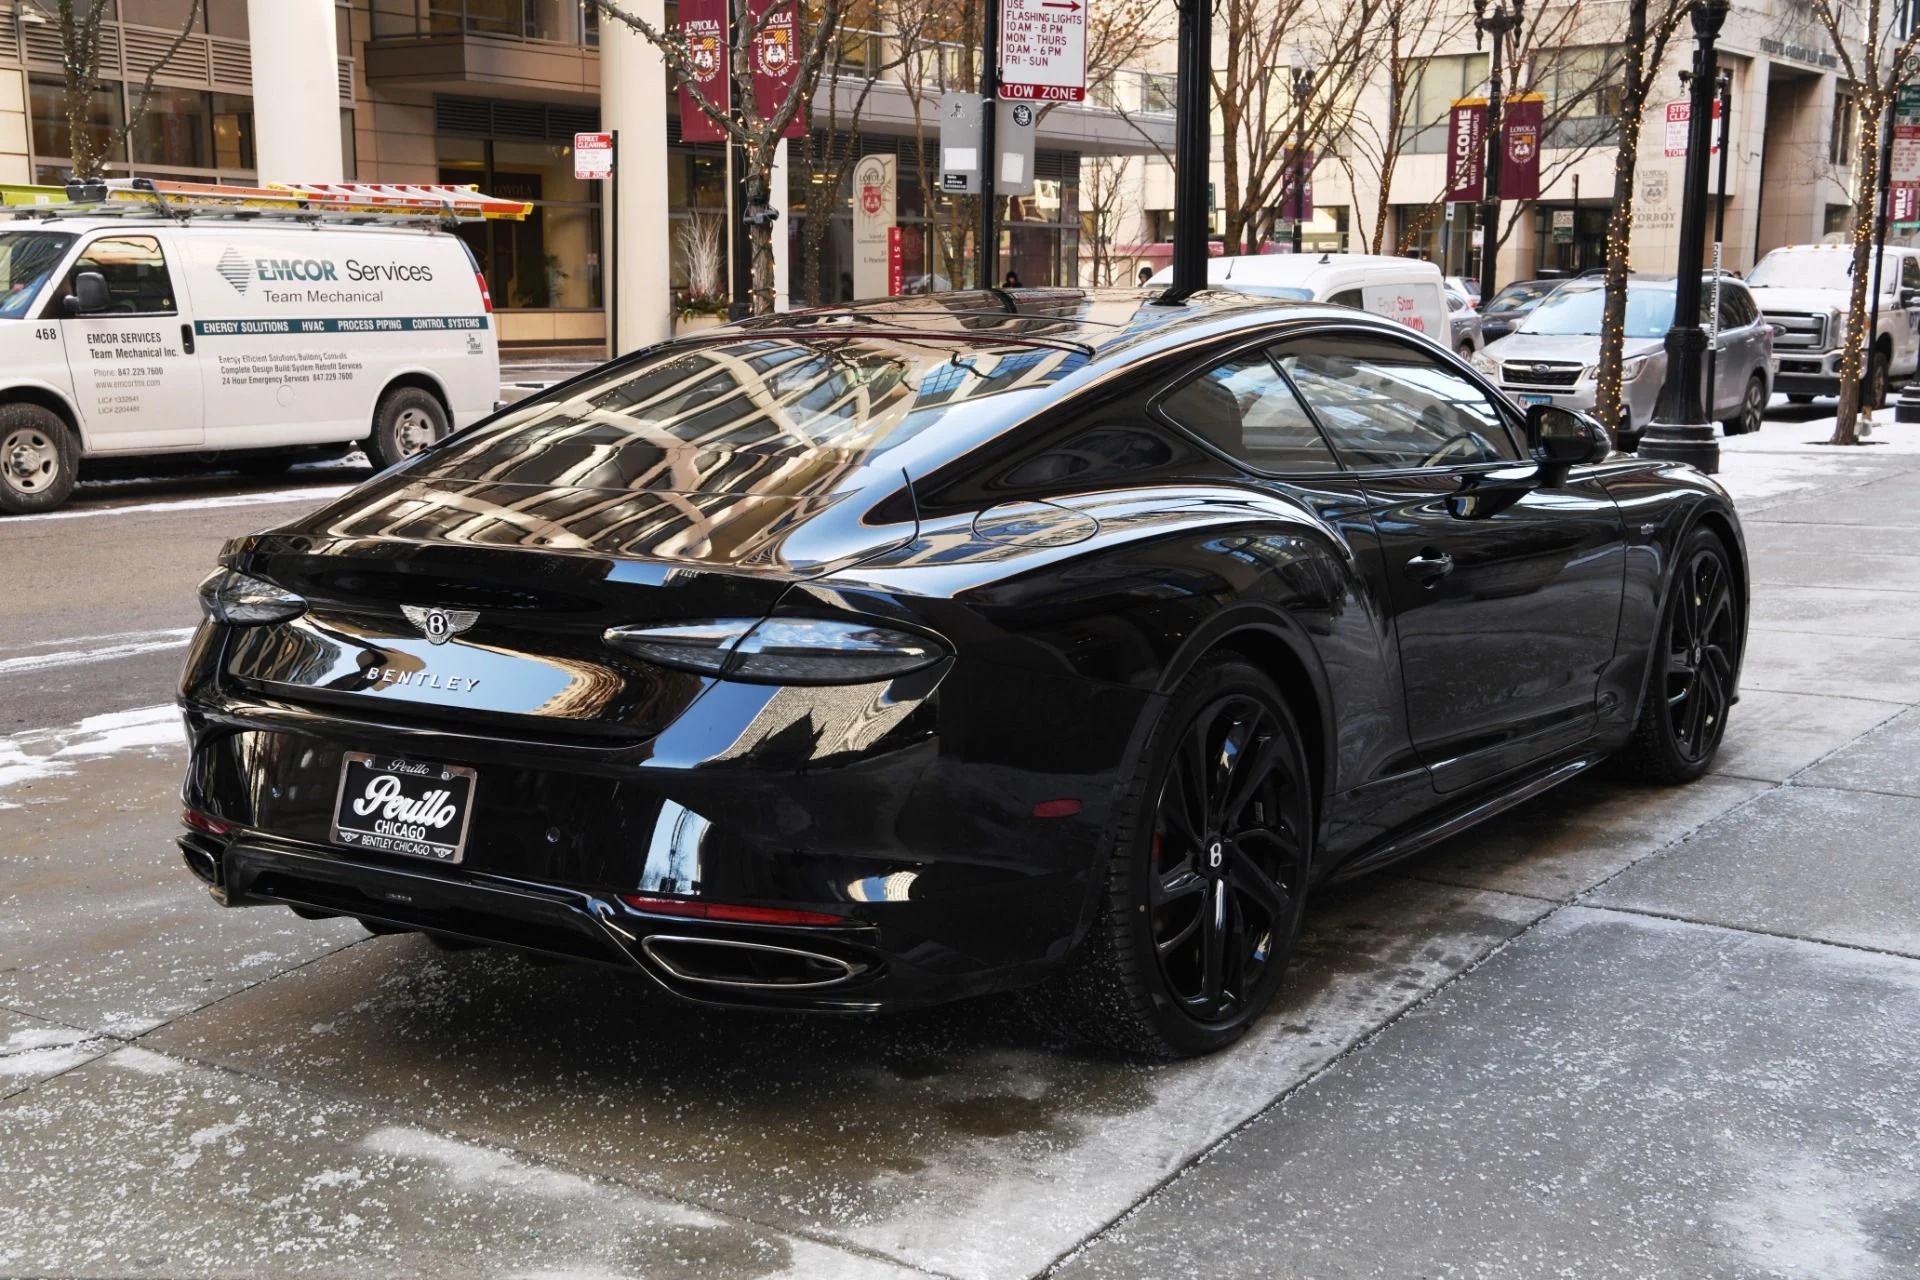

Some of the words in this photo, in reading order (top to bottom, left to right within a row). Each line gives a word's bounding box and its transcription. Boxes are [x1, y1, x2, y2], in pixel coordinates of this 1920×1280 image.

[1007, 0, 1024, 9] USE
[1006, 10, 1050, 22] FLASHING
[1052, 14, 1082, 25] LIGHTS
[1041, 24, 1047, 33] 8
[1049, 24, 1063, 34] PM
[1006, 33, 1026, 43] MON
[1036, 34, 1067, 46] THURS
[1040, 46, 1046, 56] 6
[1048, 47, 1062, 57] PM
[1005, 55, 1021, 65] FRI
[1029, 56, 1049, 67] SUN
[1005, 84, 1034, 97] TOW
[1041, 86, 1078, 100] ZONE
[1509, 125, 1537, 133] LOYOLA
[1632, 212, 1676, 221] ORBOY
[255, 258, 338, 281] EMCOR
[345, 259, 433, 282] Services
[263, 291, 303, 303] Team
[307, 290, 383, 303] Mechanical
[1397, 295, 1415, 311] Star
[203, 321, 239, 333] ENERGY
[241, 321, 289, 333] SOLUTIONS
[301, 320, 325, 331] HVAC
[337, 320, 374, 331] PROCESS
[376, 319, 402, 330] PIPING
[412, 318, 446, 329] CONTROL
[448, 318, 480, 328] SYSTEMS
[35, 328, 57, 340] 468
[87, 333, 119, 344] EMCOR
[121, 332, 162, 343] SERVICES
[90, 349, 113, 359] Team
[116, 348, 162, 359] Mechanical
[164, 348, 179, 357] Inc.
[218, 355, 241, 365] Energy
[242, 354, 267, 363] Efficient
[117, 366, 164, 377] 847.229.7600
[221, 366, 250, 375] Complete
[252, 364, 274, 375] Design
[315, 362, 338, 371] Retrofit
[338, 361, 363, 370] Services
[222, 377, 231, 385] 24
[231, 376, 247, 385] Hour
[248, 375, 282, 386] Emergency
[284, 374, 310, 383] Services
[366, 667, 480, 693] BENTLEY
[387, 758, 430, 775] Perillo
[352, 774, 457, 829] Perillo
[374, 819, 426, 840] CHICAGO
[361, 834, 393, 849] BENTLEY
[393, 840, 430, 856] CHICAGO
